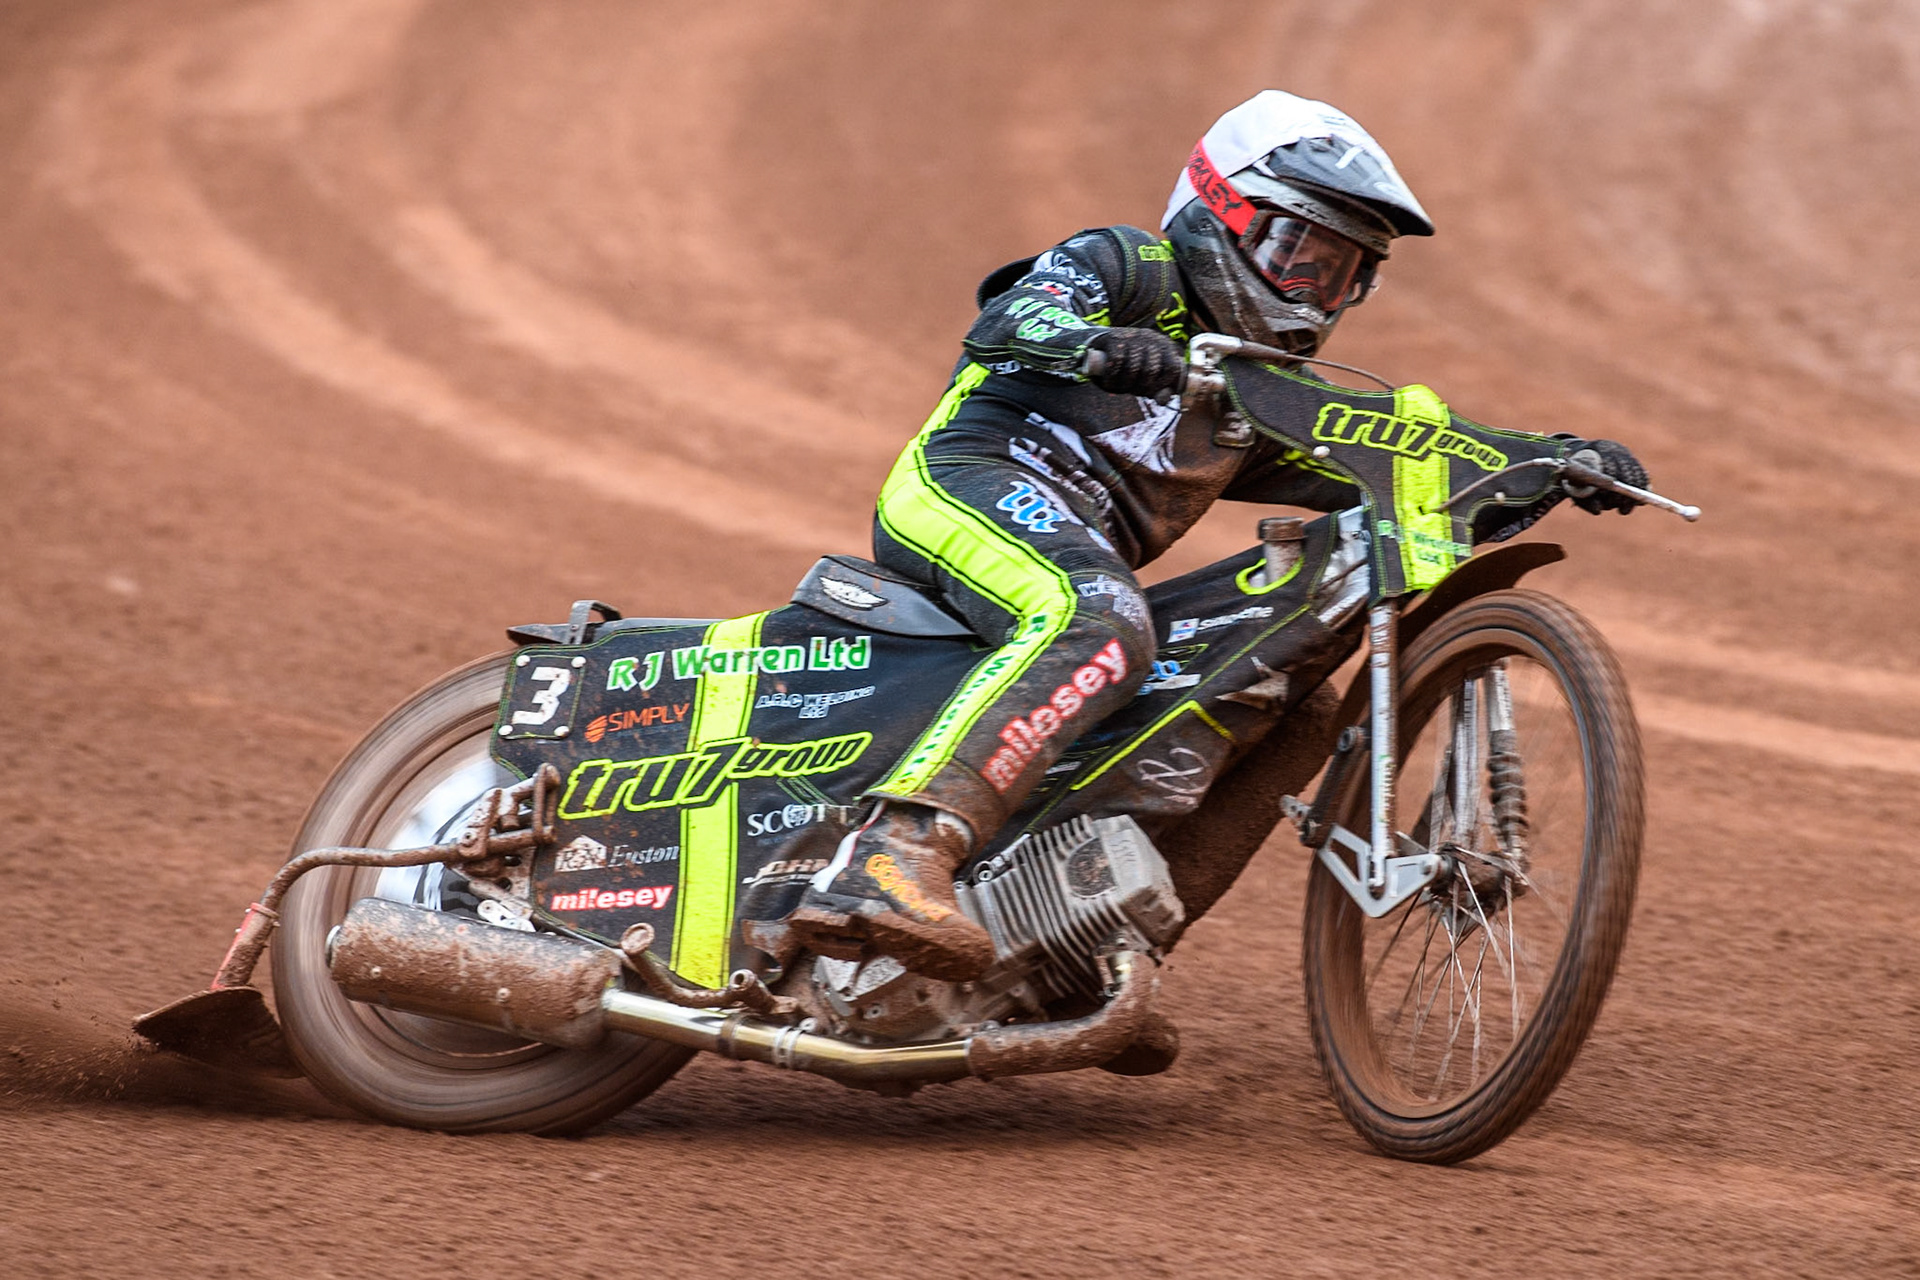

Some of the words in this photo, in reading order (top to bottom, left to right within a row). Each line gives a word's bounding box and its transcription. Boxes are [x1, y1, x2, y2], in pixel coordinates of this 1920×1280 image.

[606, 657, 640, 692] R
[671, 643, 806, 681] Warren
[808, 636, 872, 672] Ltd
[512, 666, 571, 726] 3
[607, 702, 690, 732] SIMPLY
[980, 637, 1128, 794] milesey
[551, 885, 674, 911] milesey
